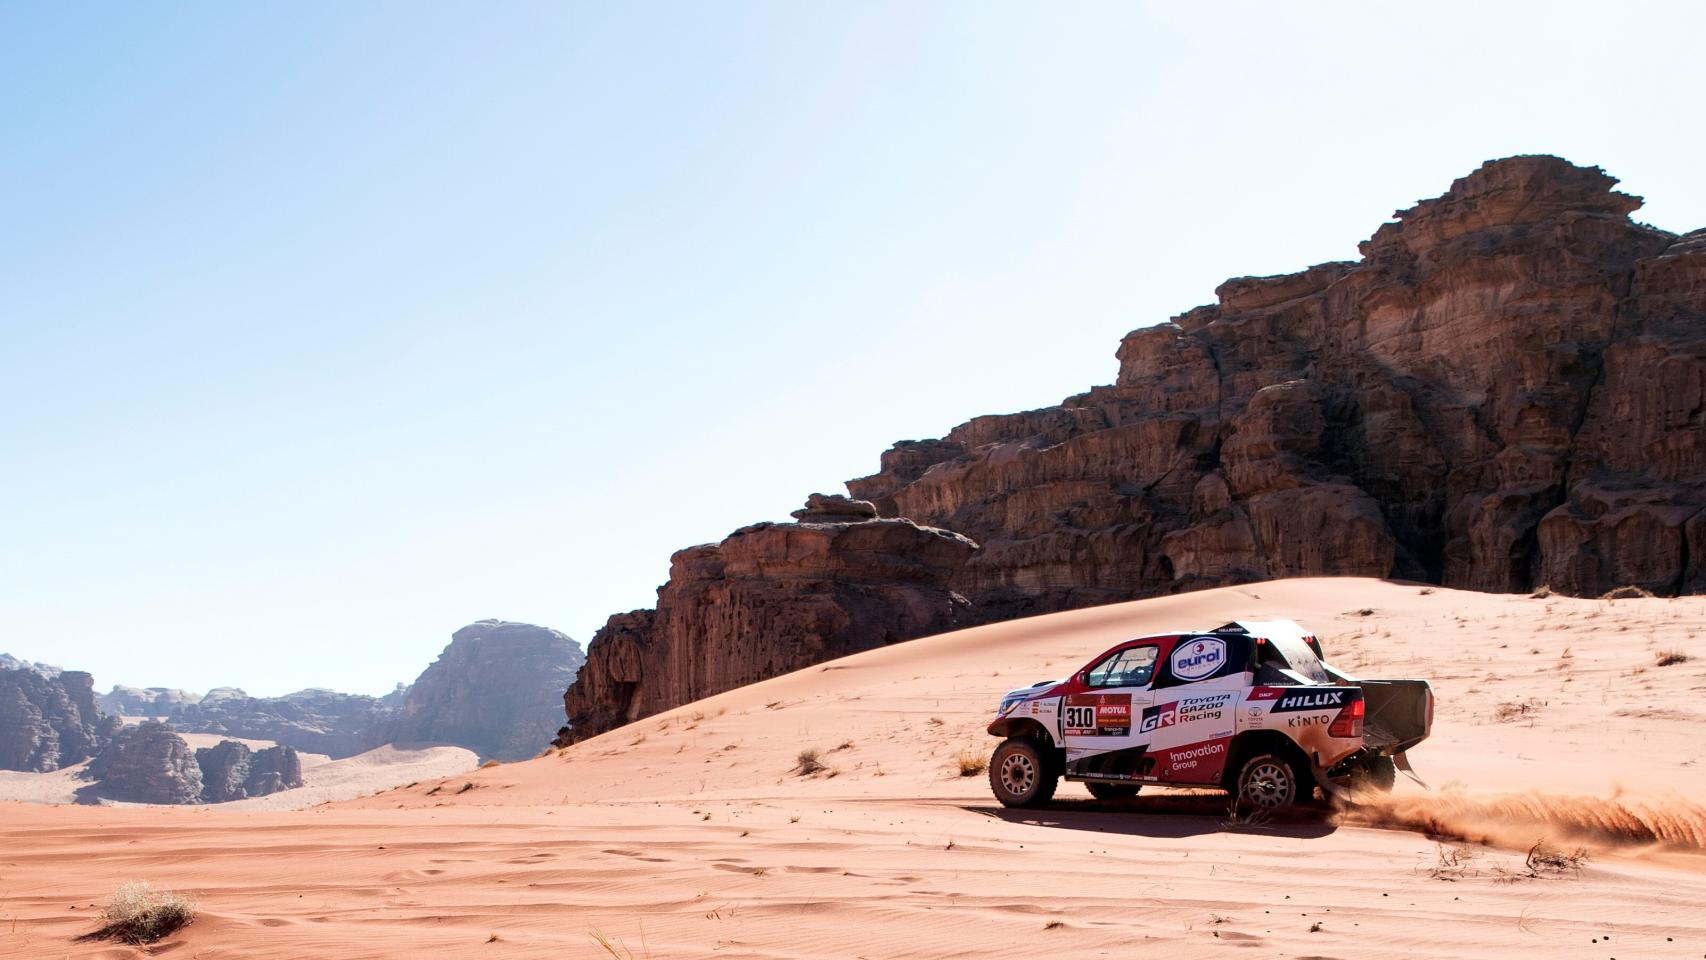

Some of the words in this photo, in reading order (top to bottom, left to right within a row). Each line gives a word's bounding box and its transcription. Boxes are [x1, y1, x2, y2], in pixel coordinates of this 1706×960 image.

[1178, 648, 1219, 669] eurol
[1182, 694, 1231, 706] TOYOTA
[1281, 691, 1344, 708] HILUX
[1099, 706, 1127, 714] MOTUL
[1180, 701, 1224, 714] GAZOO
[1066, 708, 1094, 728] 310
[1141, 711, 1175, 732] GR
[1180, 711, 1221, 723] Racing
[1170, 744, 1224, 761] Innovation
[1172, 761, 1197, 771] Group
